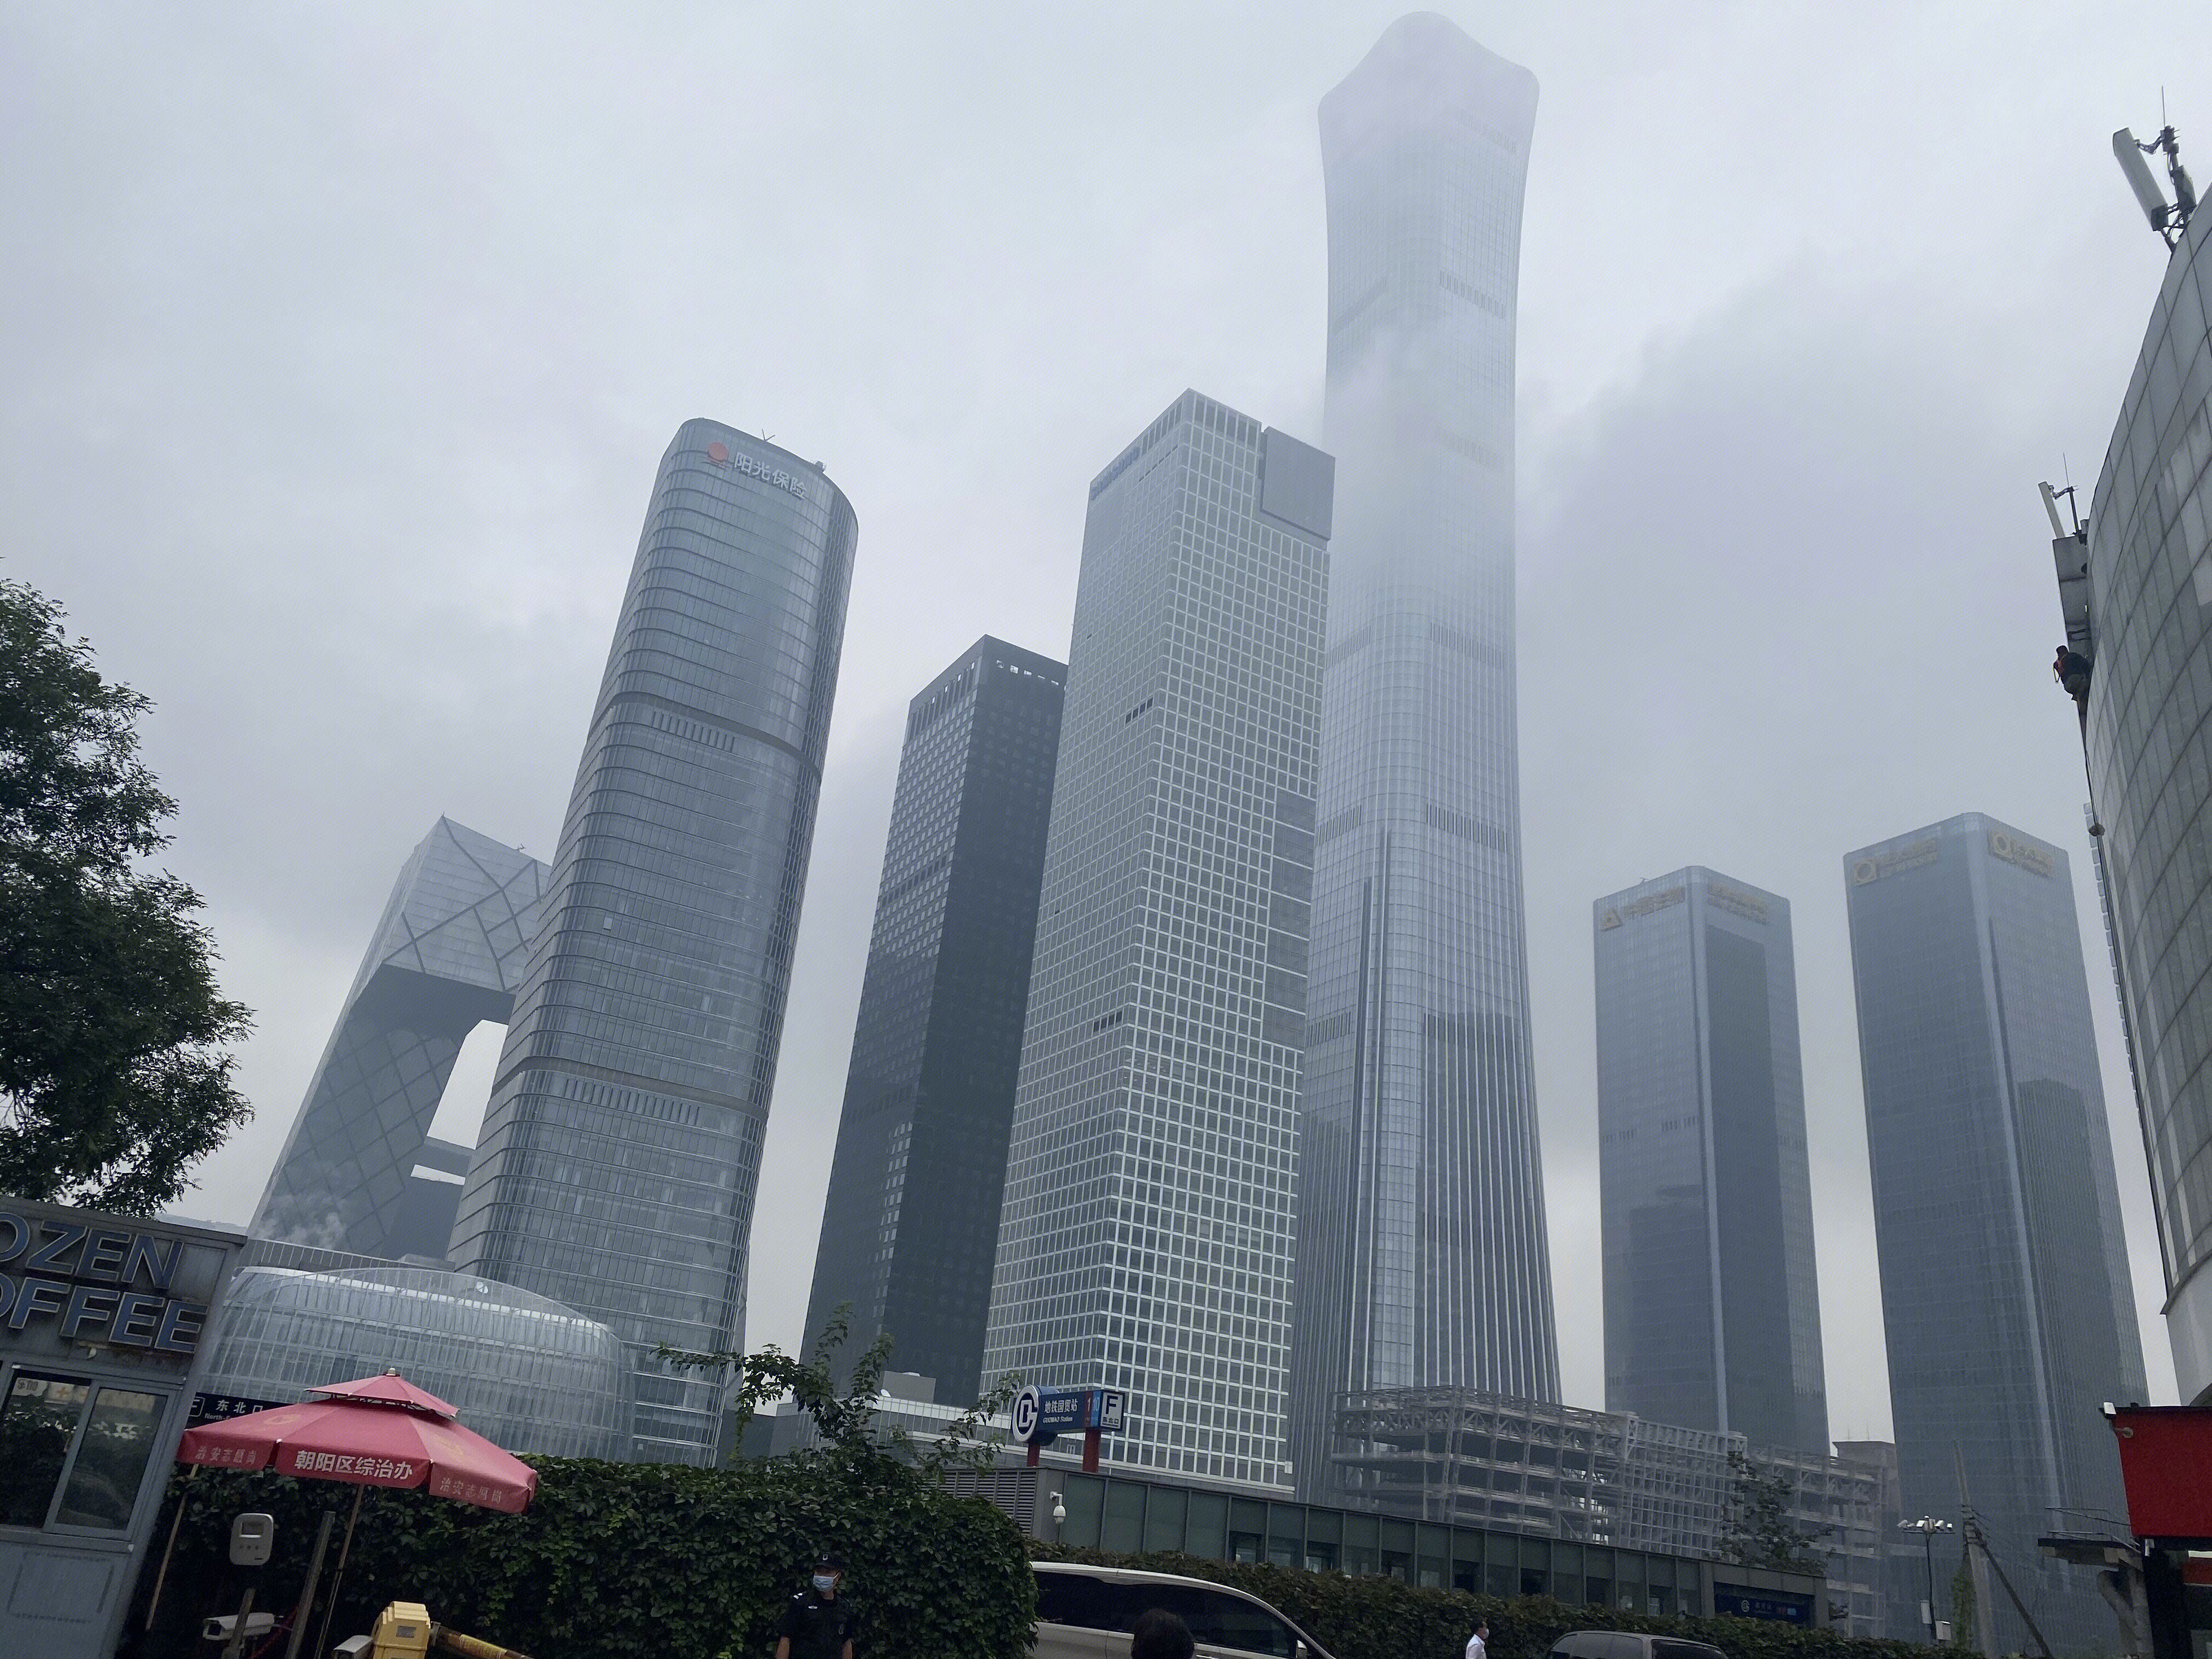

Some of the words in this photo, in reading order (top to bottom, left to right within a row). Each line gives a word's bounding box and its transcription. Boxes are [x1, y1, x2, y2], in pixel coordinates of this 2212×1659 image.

[734, 451, 808, 499] 阳光保险
[216, 1399, 263, 1414] 东北口
[1044, 1398, 1079, 1414] 地铁国贸站
[1087, 1397, 1091, 1412] 1
[1093, 1397, 1100, 1412] 10
[1105, 1395, 1118, 1414] F
[294, 1449, 413, 1480] 朝阳区综治办
